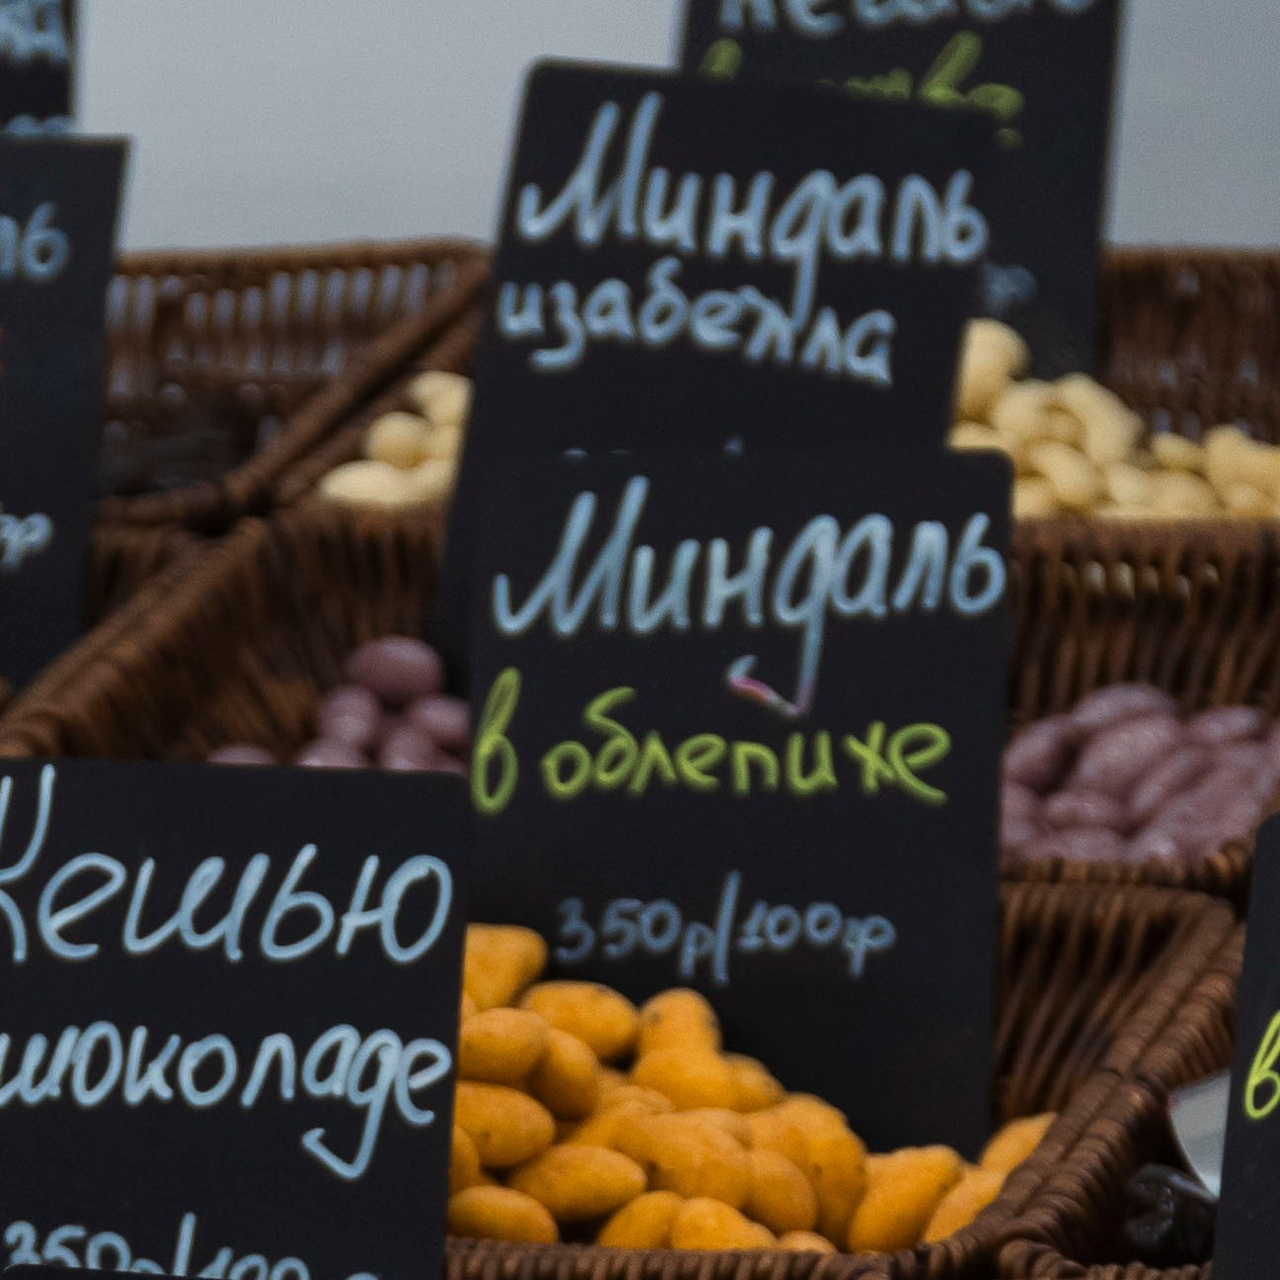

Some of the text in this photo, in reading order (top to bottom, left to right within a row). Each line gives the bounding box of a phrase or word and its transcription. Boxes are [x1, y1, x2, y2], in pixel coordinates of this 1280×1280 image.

[517, 90, 988, 332] Миндаль
[493, 475, 1007, 716] Миндаль
[471, 667, 952, 814] в облепихе
[555, 871, 896, 986] 350р/100гр
